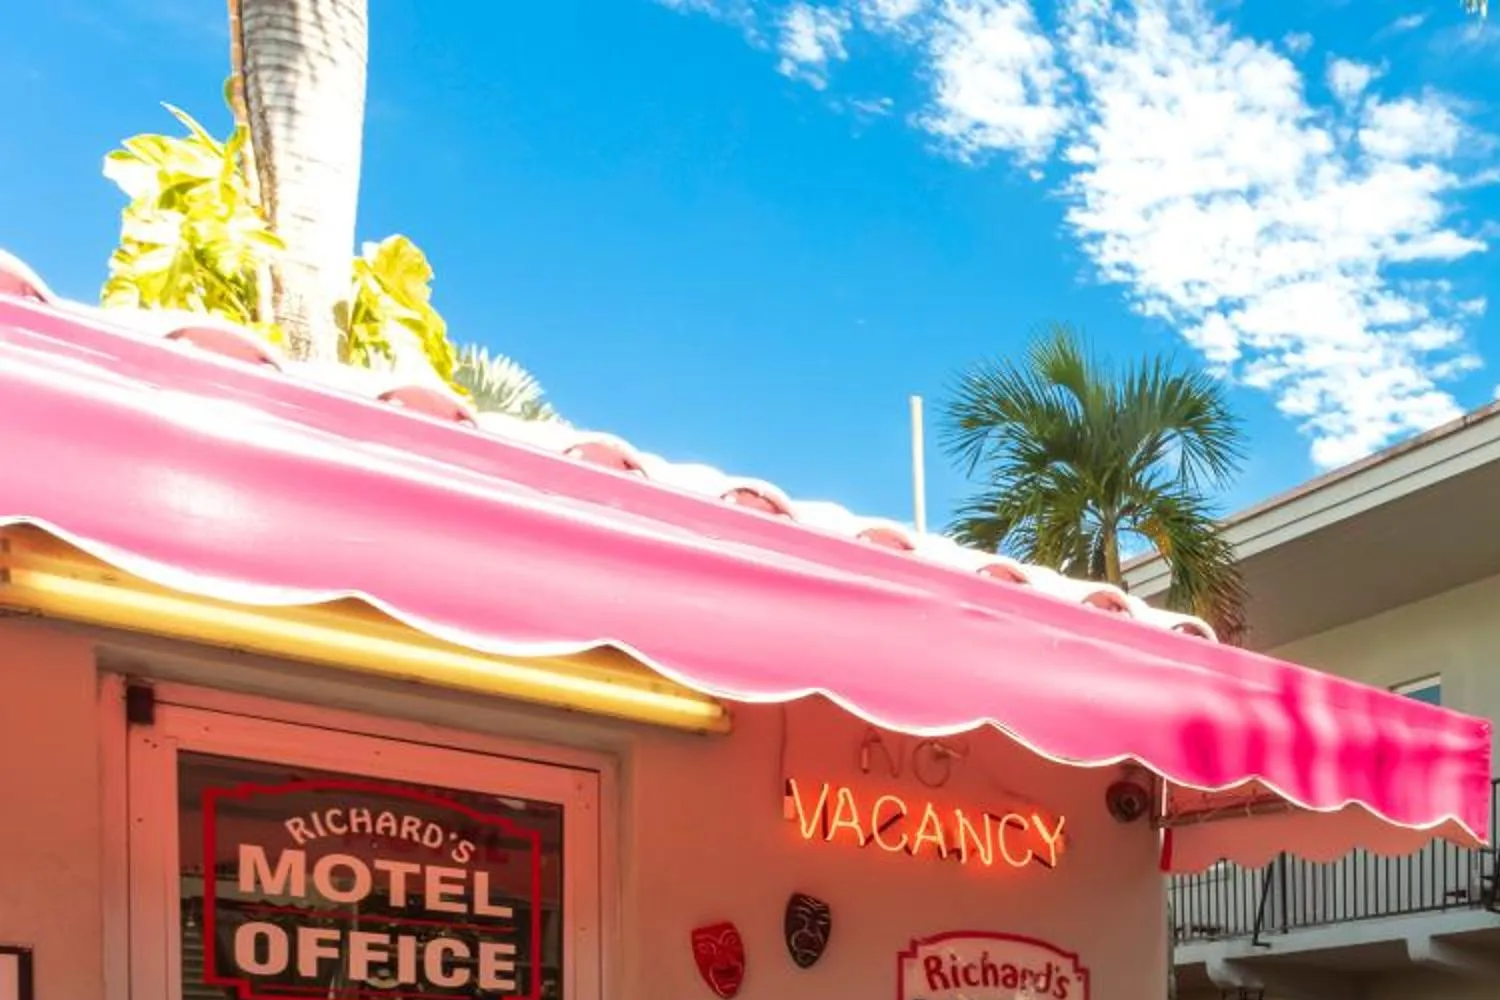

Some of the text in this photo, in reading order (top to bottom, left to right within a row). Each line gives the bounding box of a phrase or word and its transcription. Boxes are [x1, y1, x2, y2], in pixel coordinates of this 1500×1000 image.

[285, 808, 476, 863] RICHARD'S
[788, 777, 1066, 868] VACANCY
[238, 843, 513, 918] MOTEL
[234, 922, 517, 991] OFFICE
[923, 951, 1071, 1000] Richard's
